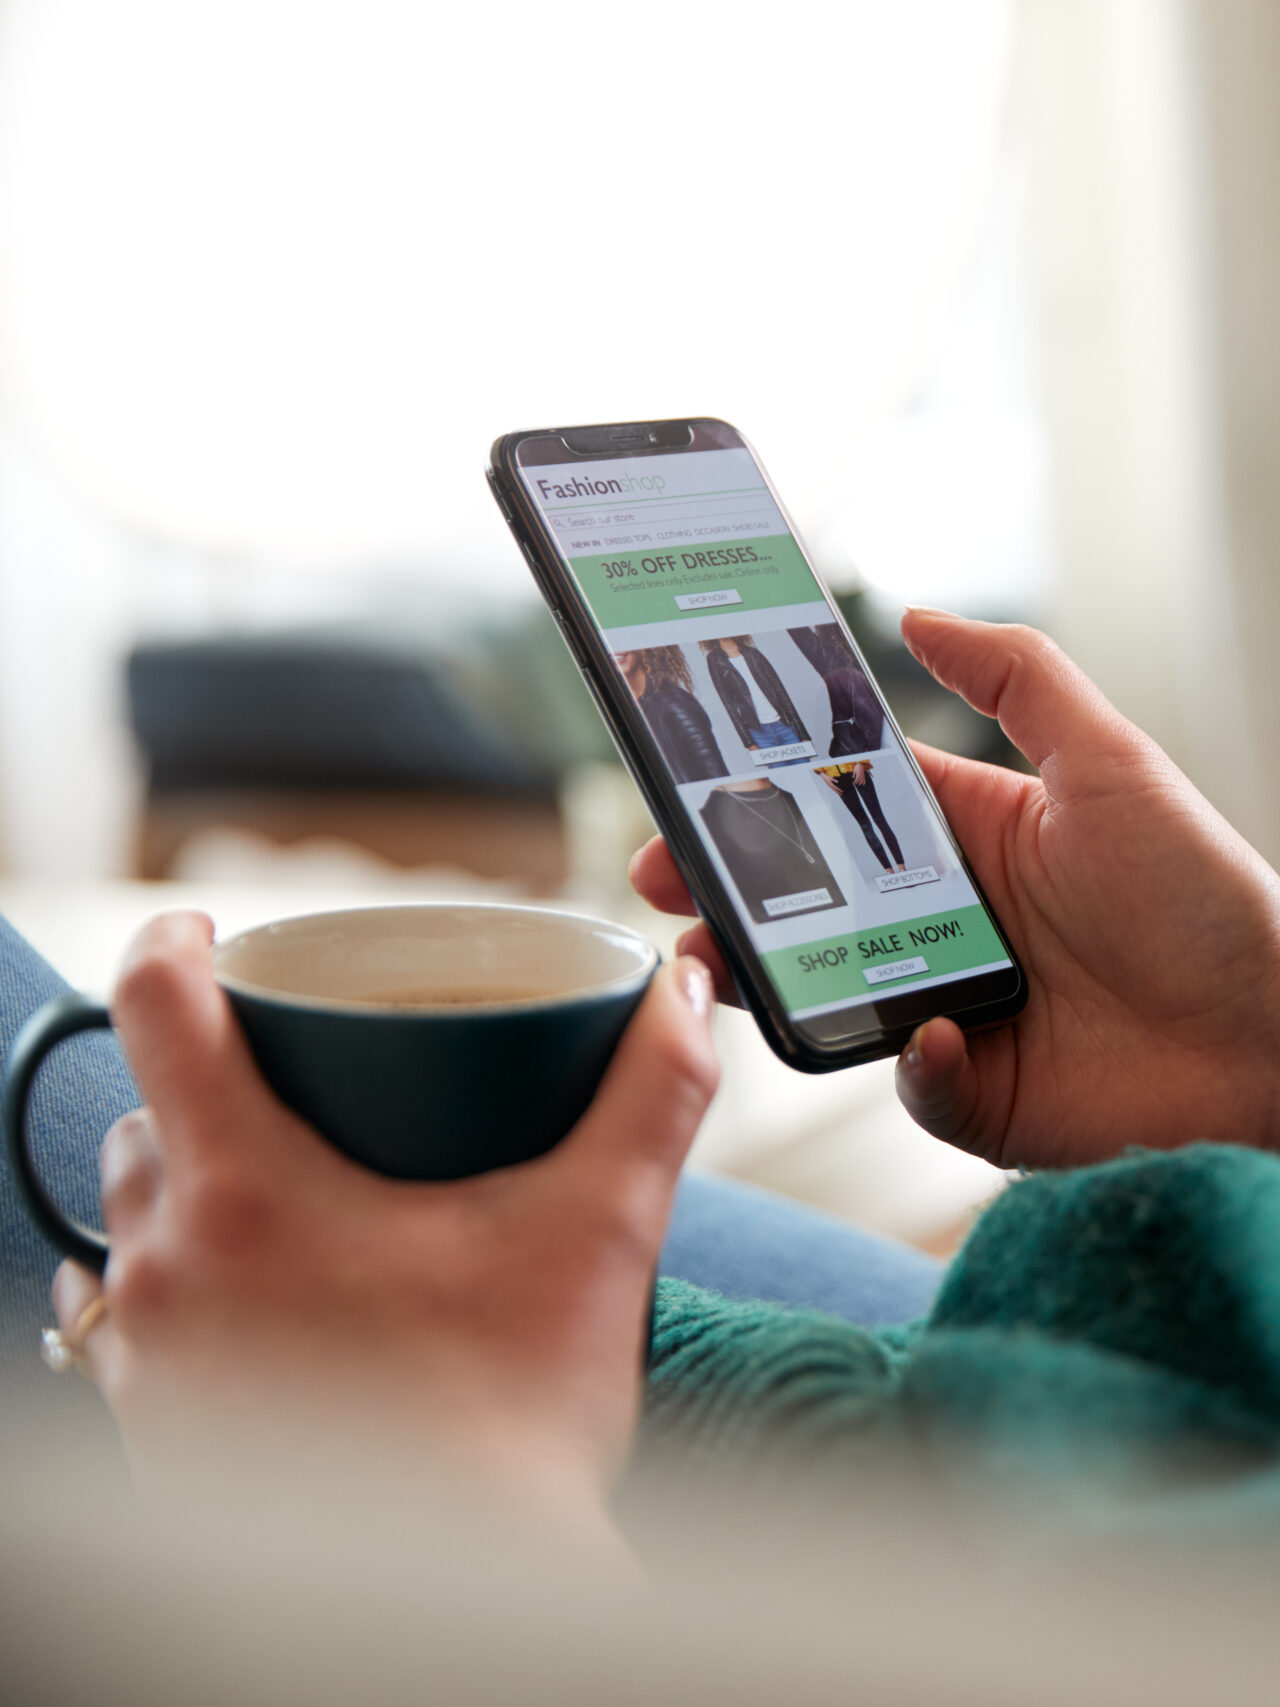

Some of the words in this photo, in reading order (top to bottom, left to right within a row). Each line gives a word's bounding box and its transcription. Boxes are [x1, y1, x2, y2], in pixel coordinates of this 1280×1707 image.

[536, 472, 666, 500] Fashionshop
[567, 515, 597, 527] Search
[598, 515, 612, 524] our
[613, 513, 635, 523] store
[571, 539, 590, 549] NEW
[591, 539, 601, 547] IN
[604, 535, 634, 546] DRESSES
[635, 533, 652, 542] TOPS
[656, 529, 692, 540] CLOTHING
[694, 526, 730, 536] OCCASION
[601, 559, 638, 579] 30%
[641, 555, 677, 574] OFF
[681, 546, 773, 570] DRESSES...
[609, 580, 645, 592] Selected
[646, 578, 664, 589] lines
[682, 572, 716, 584] Excludes
[734, 567, 761, 578] Online
[688, 595, 709, 605] SHOP
[709, 593, 728, 603] NOW
[760, 751, 779, 760] SHOP
[779, 745, 807, 758] JACKETS
[881, 877, 901, 887] SHOP
[901, 870, 933, 883] BOTTOMS
[767, 900, 788, 912] SHOP
[787, 893, 829, 907] ACCESSORIES
[797, 946, 848, 973] SHOP
[857, 934, 904, 959] SALE
[908, 920, 964, 948] NOW!
[875, 965, 898, 978] SHOP
[898, 961, 915, 973] NOW
